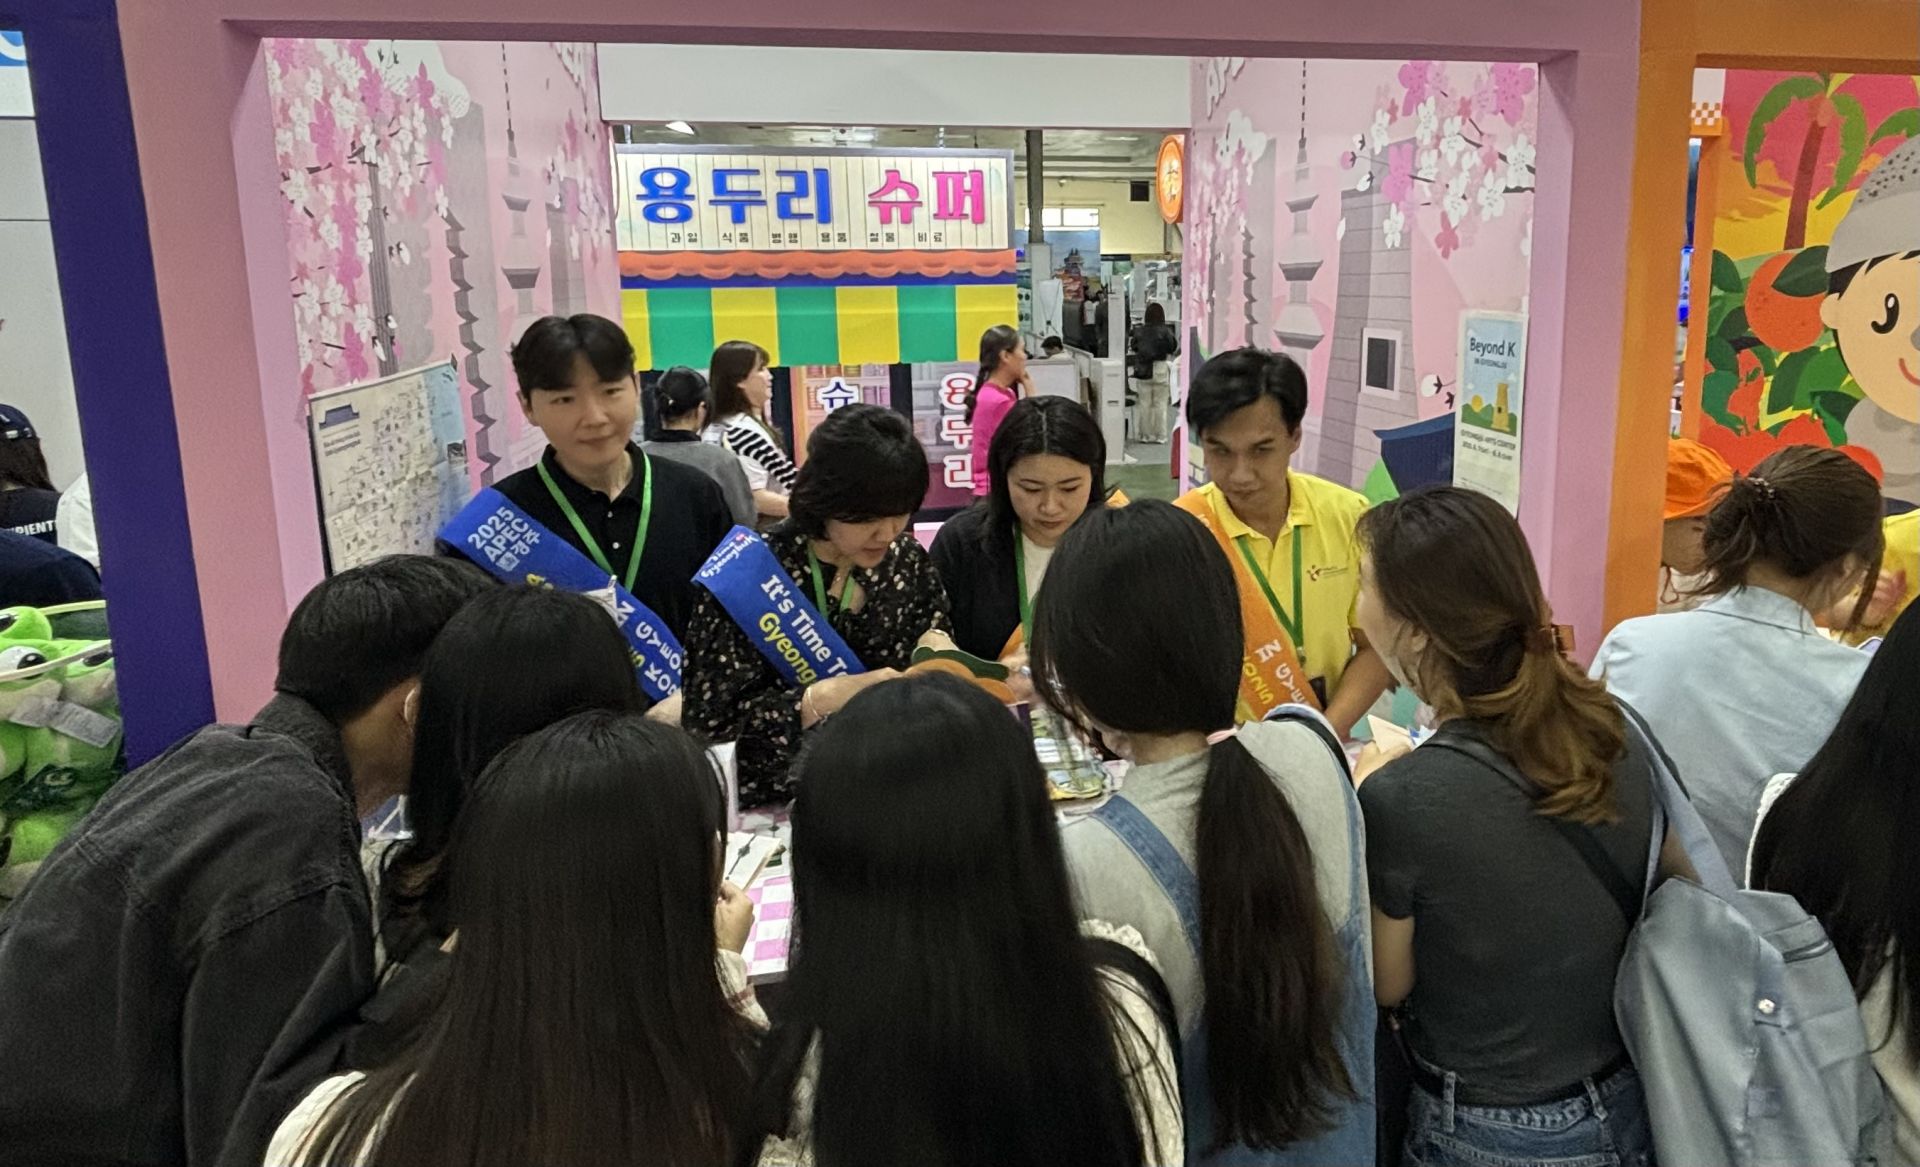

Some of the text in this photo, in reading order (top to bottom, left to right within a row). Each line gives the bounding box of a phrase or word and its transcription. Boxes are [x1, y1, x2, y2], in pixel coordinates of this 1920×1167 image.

[635, 165, 985, 225] 용두리 슈퍼
[1469, 337, 1516, 358] Beyond K
[467, 506, 515, 549] 2025
[483, 518, 529, 562] APEC
[510, 528, 541, 555] 경주
[760, 574, 795, 615] It's
[791, 608, 832, 662] Time
[635, 621, 682, 676] GYEO
[1254, 639, 1310, 704] IN GYE
